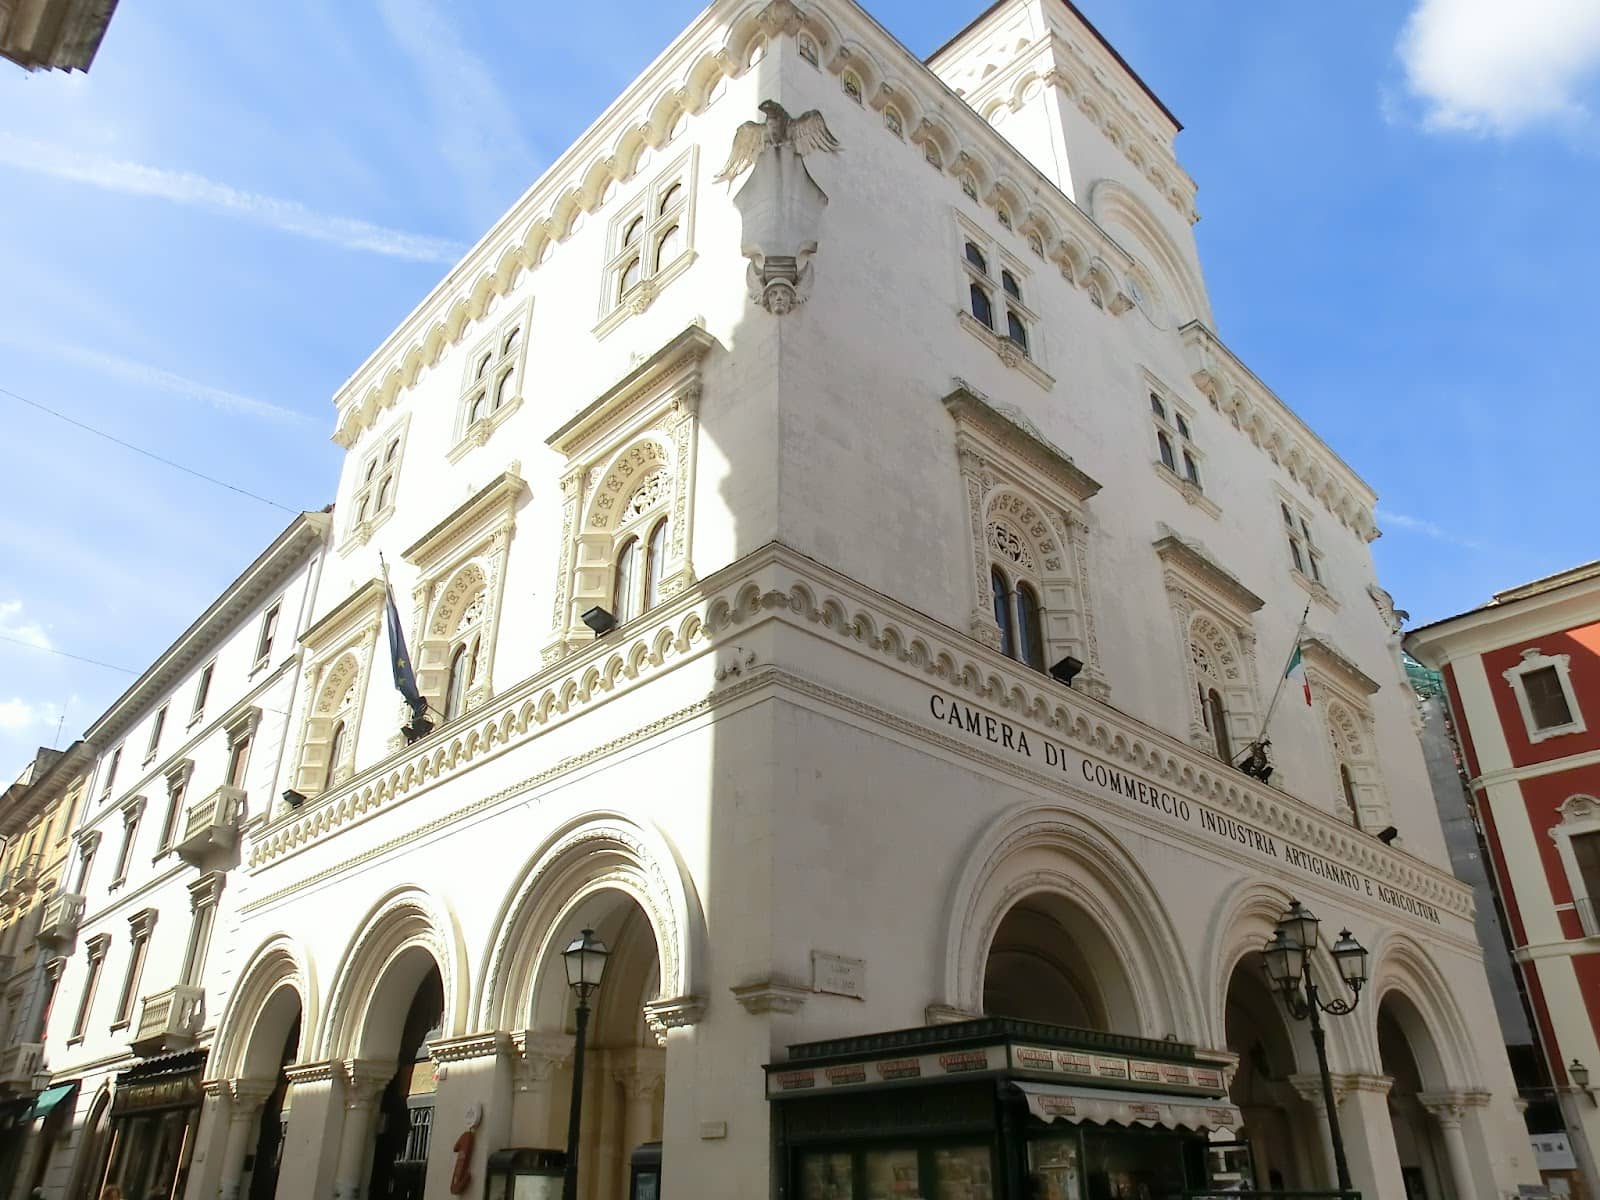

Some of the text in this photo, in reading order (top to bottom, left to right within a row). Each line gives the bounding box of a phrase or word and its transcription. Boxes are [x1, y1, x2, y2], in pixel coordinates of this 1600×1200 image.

[930, 694, 1440, 925] CAMERA DI COMMERCIO INDUSTRIA ARTIGIANATO E AGRICOLTURA
